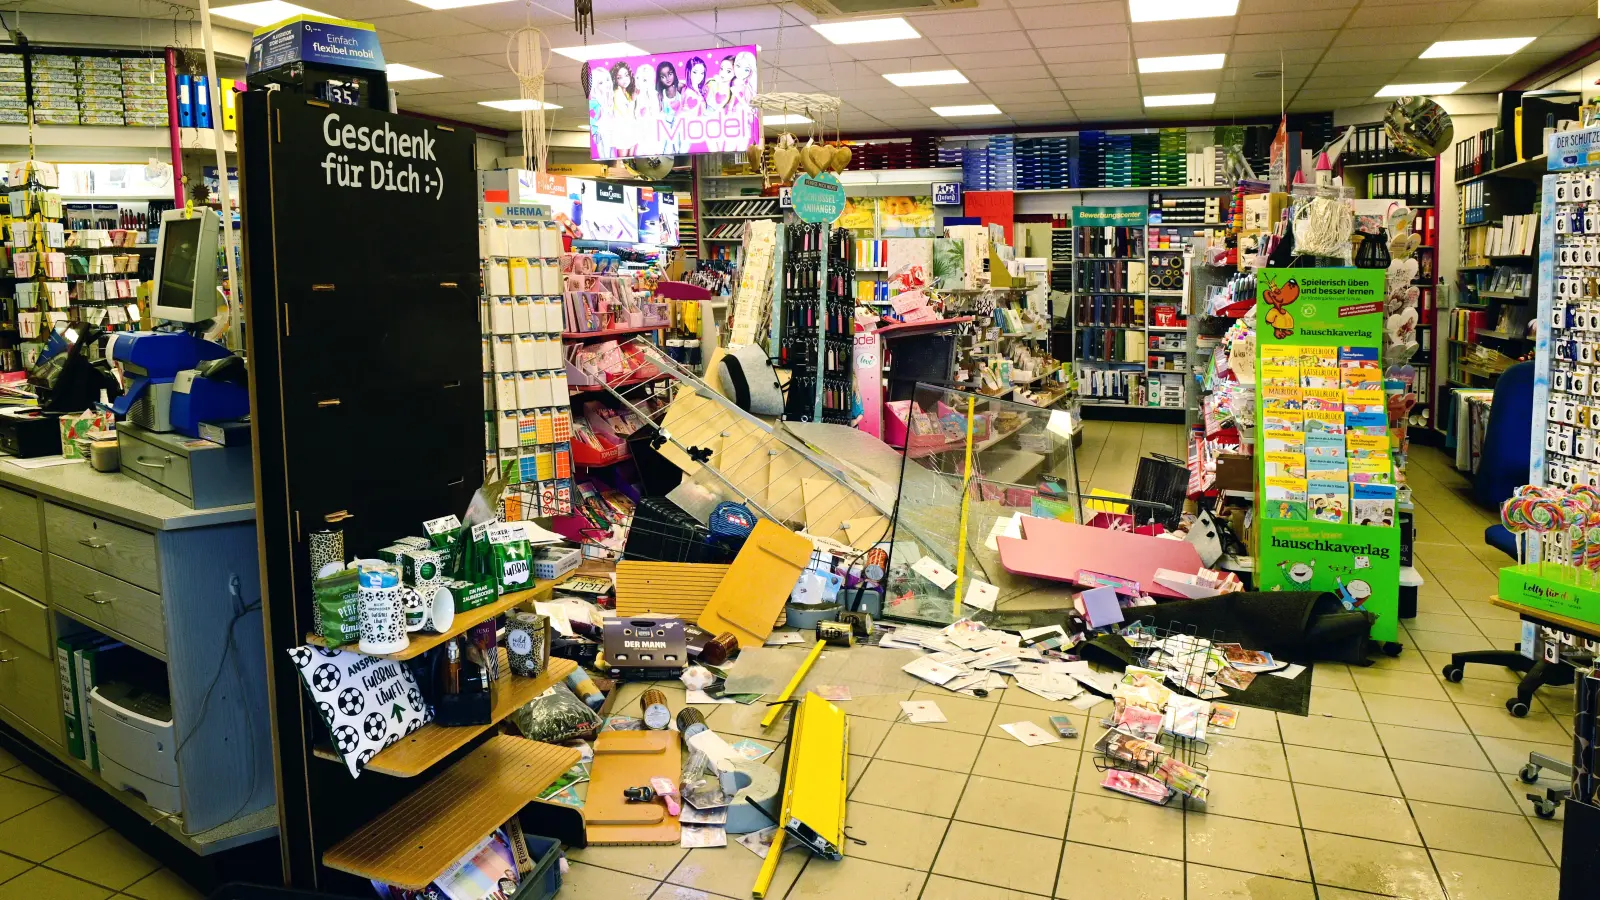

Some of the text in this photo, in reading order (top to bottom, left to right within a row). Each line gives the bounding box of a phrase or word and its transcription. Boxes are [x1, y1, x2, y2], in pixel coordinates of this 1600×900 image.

[326, 33, 359, 46] Einfach
[312, 42, 348, 56] flexibel
[349, 48, 375, 59] mobil
[656, 108, 746, 142] Model
[323, 112, 437, 162] Geschenk
[1556, 131, 1600, 149] DER SCHUTZE
[320, 152, 365, 188] für
[370, 160, 420, 194] Dich
[506, 207, 543, 217] HERMA
[1079, 211, 1142, 220] Bewerbungscenter
[1301, 279, 1369, 287] Spielerisch üben
[1301, 287, 1374, 296] und besser lernen
[854, 333, 876, 346] odel
[1300, 328, 1372, 339] hauschkaverlag
[1271, 536, 1390, 559] hauschkaverlag
[572, 581, 605, 592] Held
[1523, 581, 1544, 597] Lolly
[1545, 587, 1559, 598] für
[338, 605, 359, 618] PERF
[340, 622, 360, 633] limi
[345, 631, 359, 640] EDIT
[624, 640, 667, 649] DER MANN
